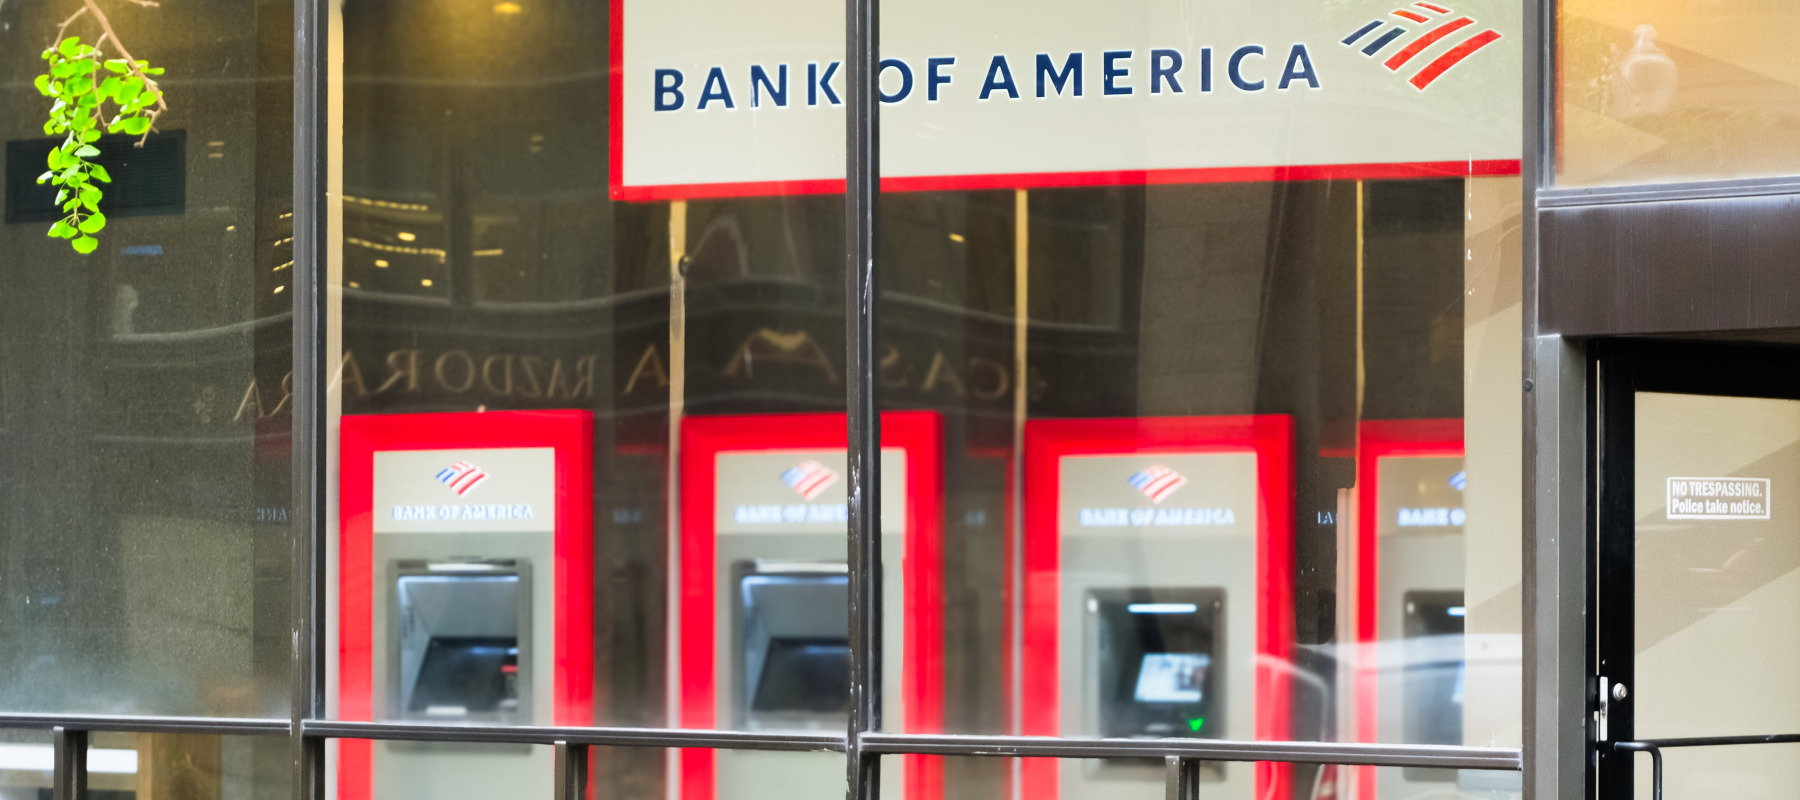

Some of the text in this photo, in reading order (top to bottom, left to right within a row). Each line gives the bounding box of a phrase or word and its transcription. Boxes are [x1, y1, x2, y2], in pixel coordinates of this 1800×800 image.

[653, 44, 1321, 112] BANK OF AMERICA
[1672, 481, 1763, 497] NO TRESPASSING.
[392, 504, 534, 520] BANK OF AMERICA
[1672, 498, 1765, 514] Police take notice.
